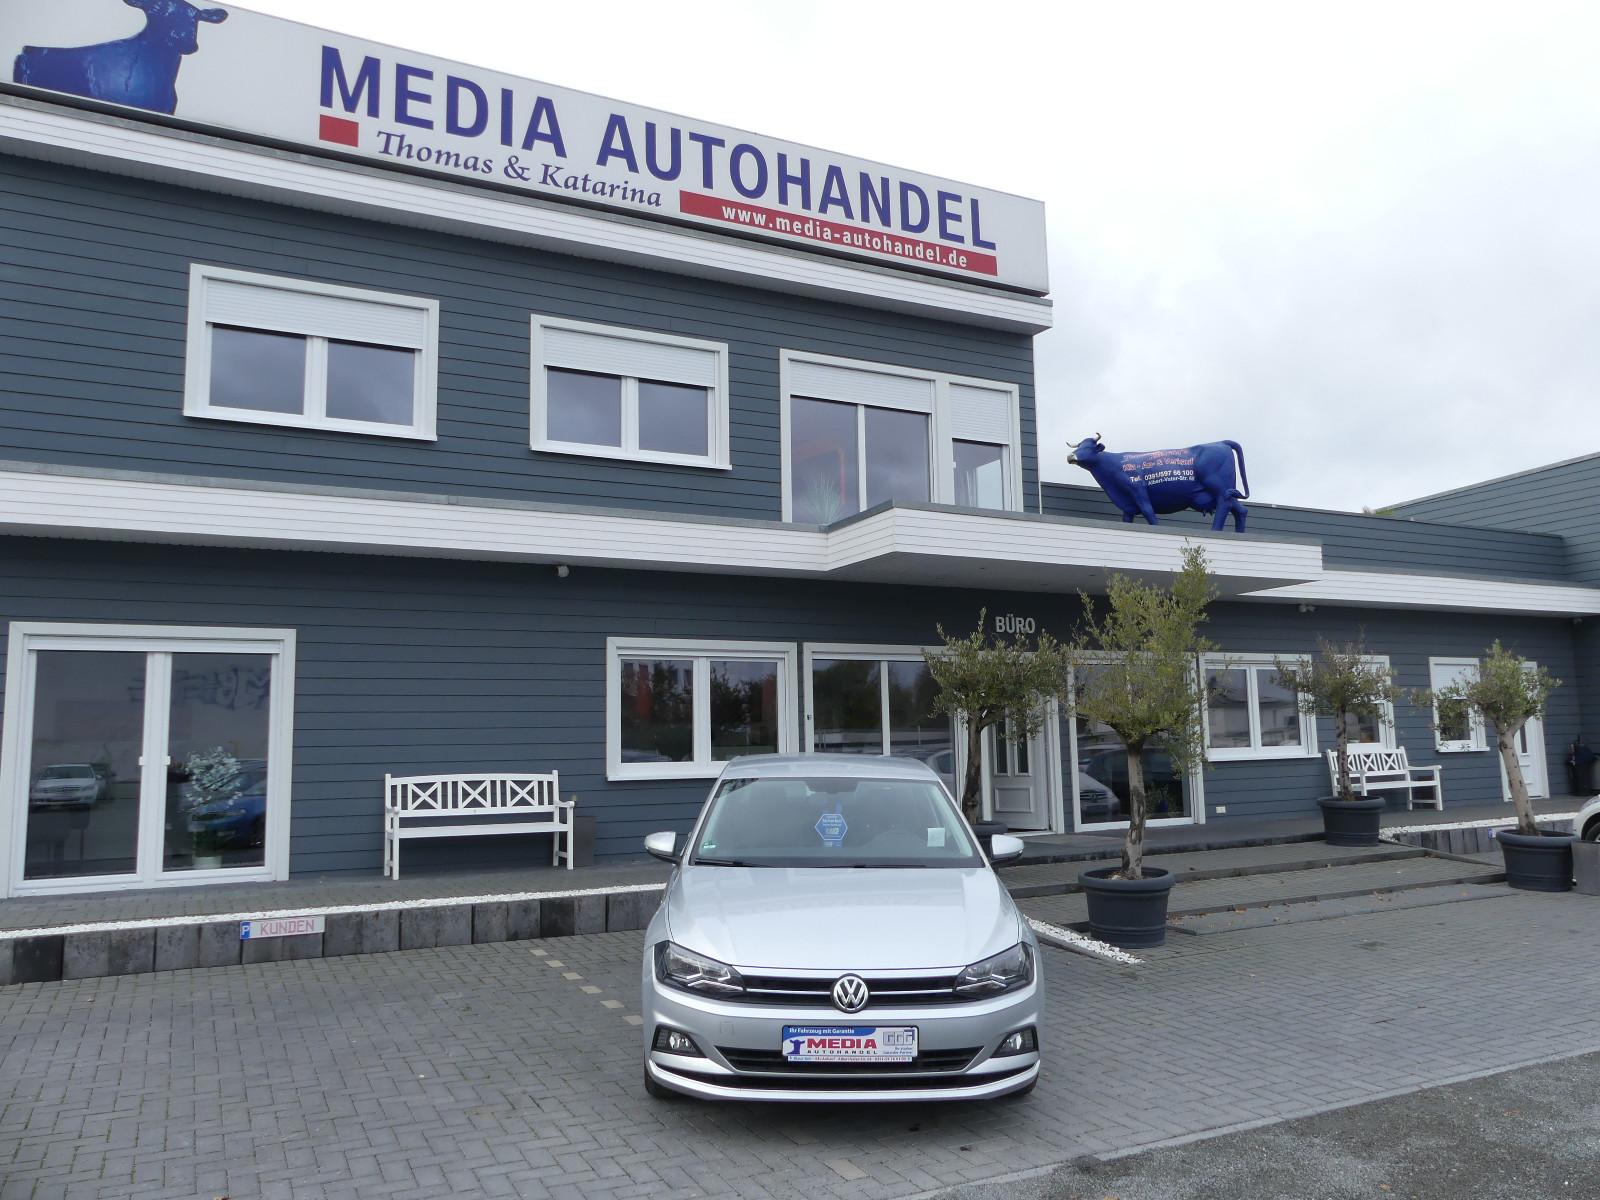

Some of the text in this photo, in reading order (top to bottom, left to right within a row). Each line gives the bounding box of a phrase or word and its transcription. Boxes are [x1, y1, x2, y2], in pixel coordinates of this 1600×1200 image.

[320, 45, 996, 251] MEDIA AUTOHANDEL
[376, 130, 663, 208] Thomas & Katarina
[722, 204, 968, 268] www.media-autohandel.de
[995, 613, 1036, 634] BÜRO
[241, 920, 315, 936] P KUNDEN
[797, 1027, 822, 1035] Fahrzeug
[807, 1038, 877, 1049] MEDIA
